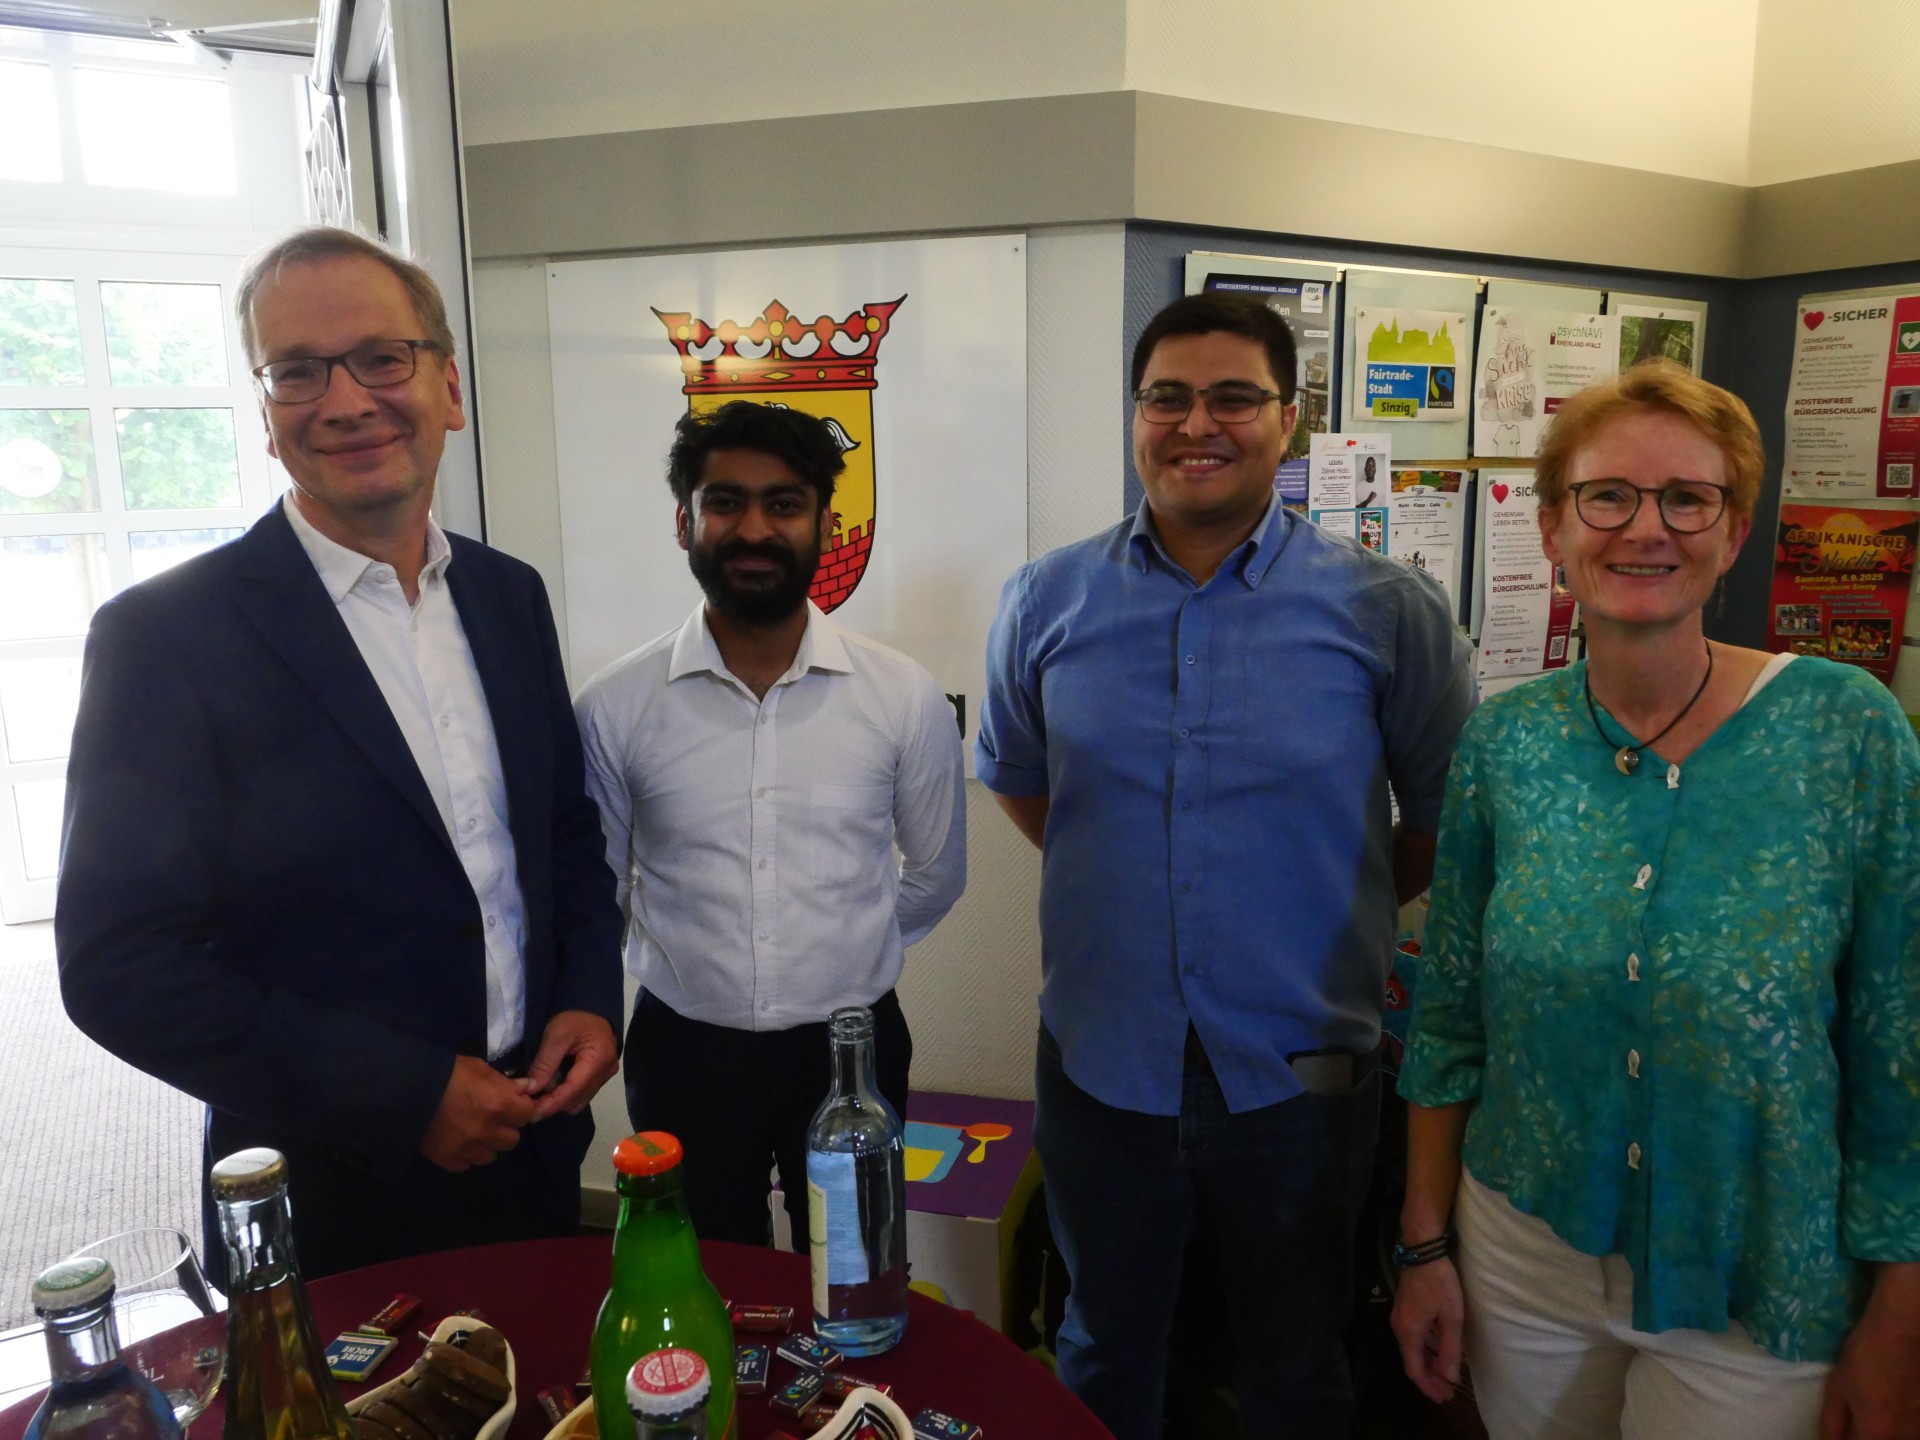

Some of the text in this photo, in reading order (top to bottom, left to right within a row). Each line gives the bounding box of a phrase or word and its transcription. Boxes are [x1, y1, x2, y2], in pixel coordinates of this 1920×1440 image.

[1827, 308, 1888, 323] -SICHER
[1557, 326, 1602, 340] psychNAVi
[1557, 340, 1602, 349] RHEINLAND-PFALZ
[1803, 336, 1845, 345] GEMEINSAM
[1802, 343, 1853, 352] LEBEN RETTEN
[1369, 369, 1414, 380] Fairtrade-
[1368, 383, 1393, 394] Stadt
[1795, 397, 1854, 406] KOSTENFREIE
[1381, 402, 1410, 416] Sinzig
[1793, 406, 1877, 416] BÜRGERSCHULUNG
[1511, 486, 1539, 497] -SICH
[1493, 511, 1525, 519] GEMEINSAM
[1493, 518, 1530, 527] LEBEN RETTEN
[1786, 528, 1906, 551] AFRIKANISCHE
[1800, 550, 1881, 574] Nacht
[1492, 573, 1533, 582] KOSTENFREIE
[1795, 575, 1838, 583] Samstag,
[1492, 582, 1548, 593] BÜRGERSCHULUNG
[341, 1345, 376, 1354] WOCHE
[340, 1353, 370, 1362] FAIRE
